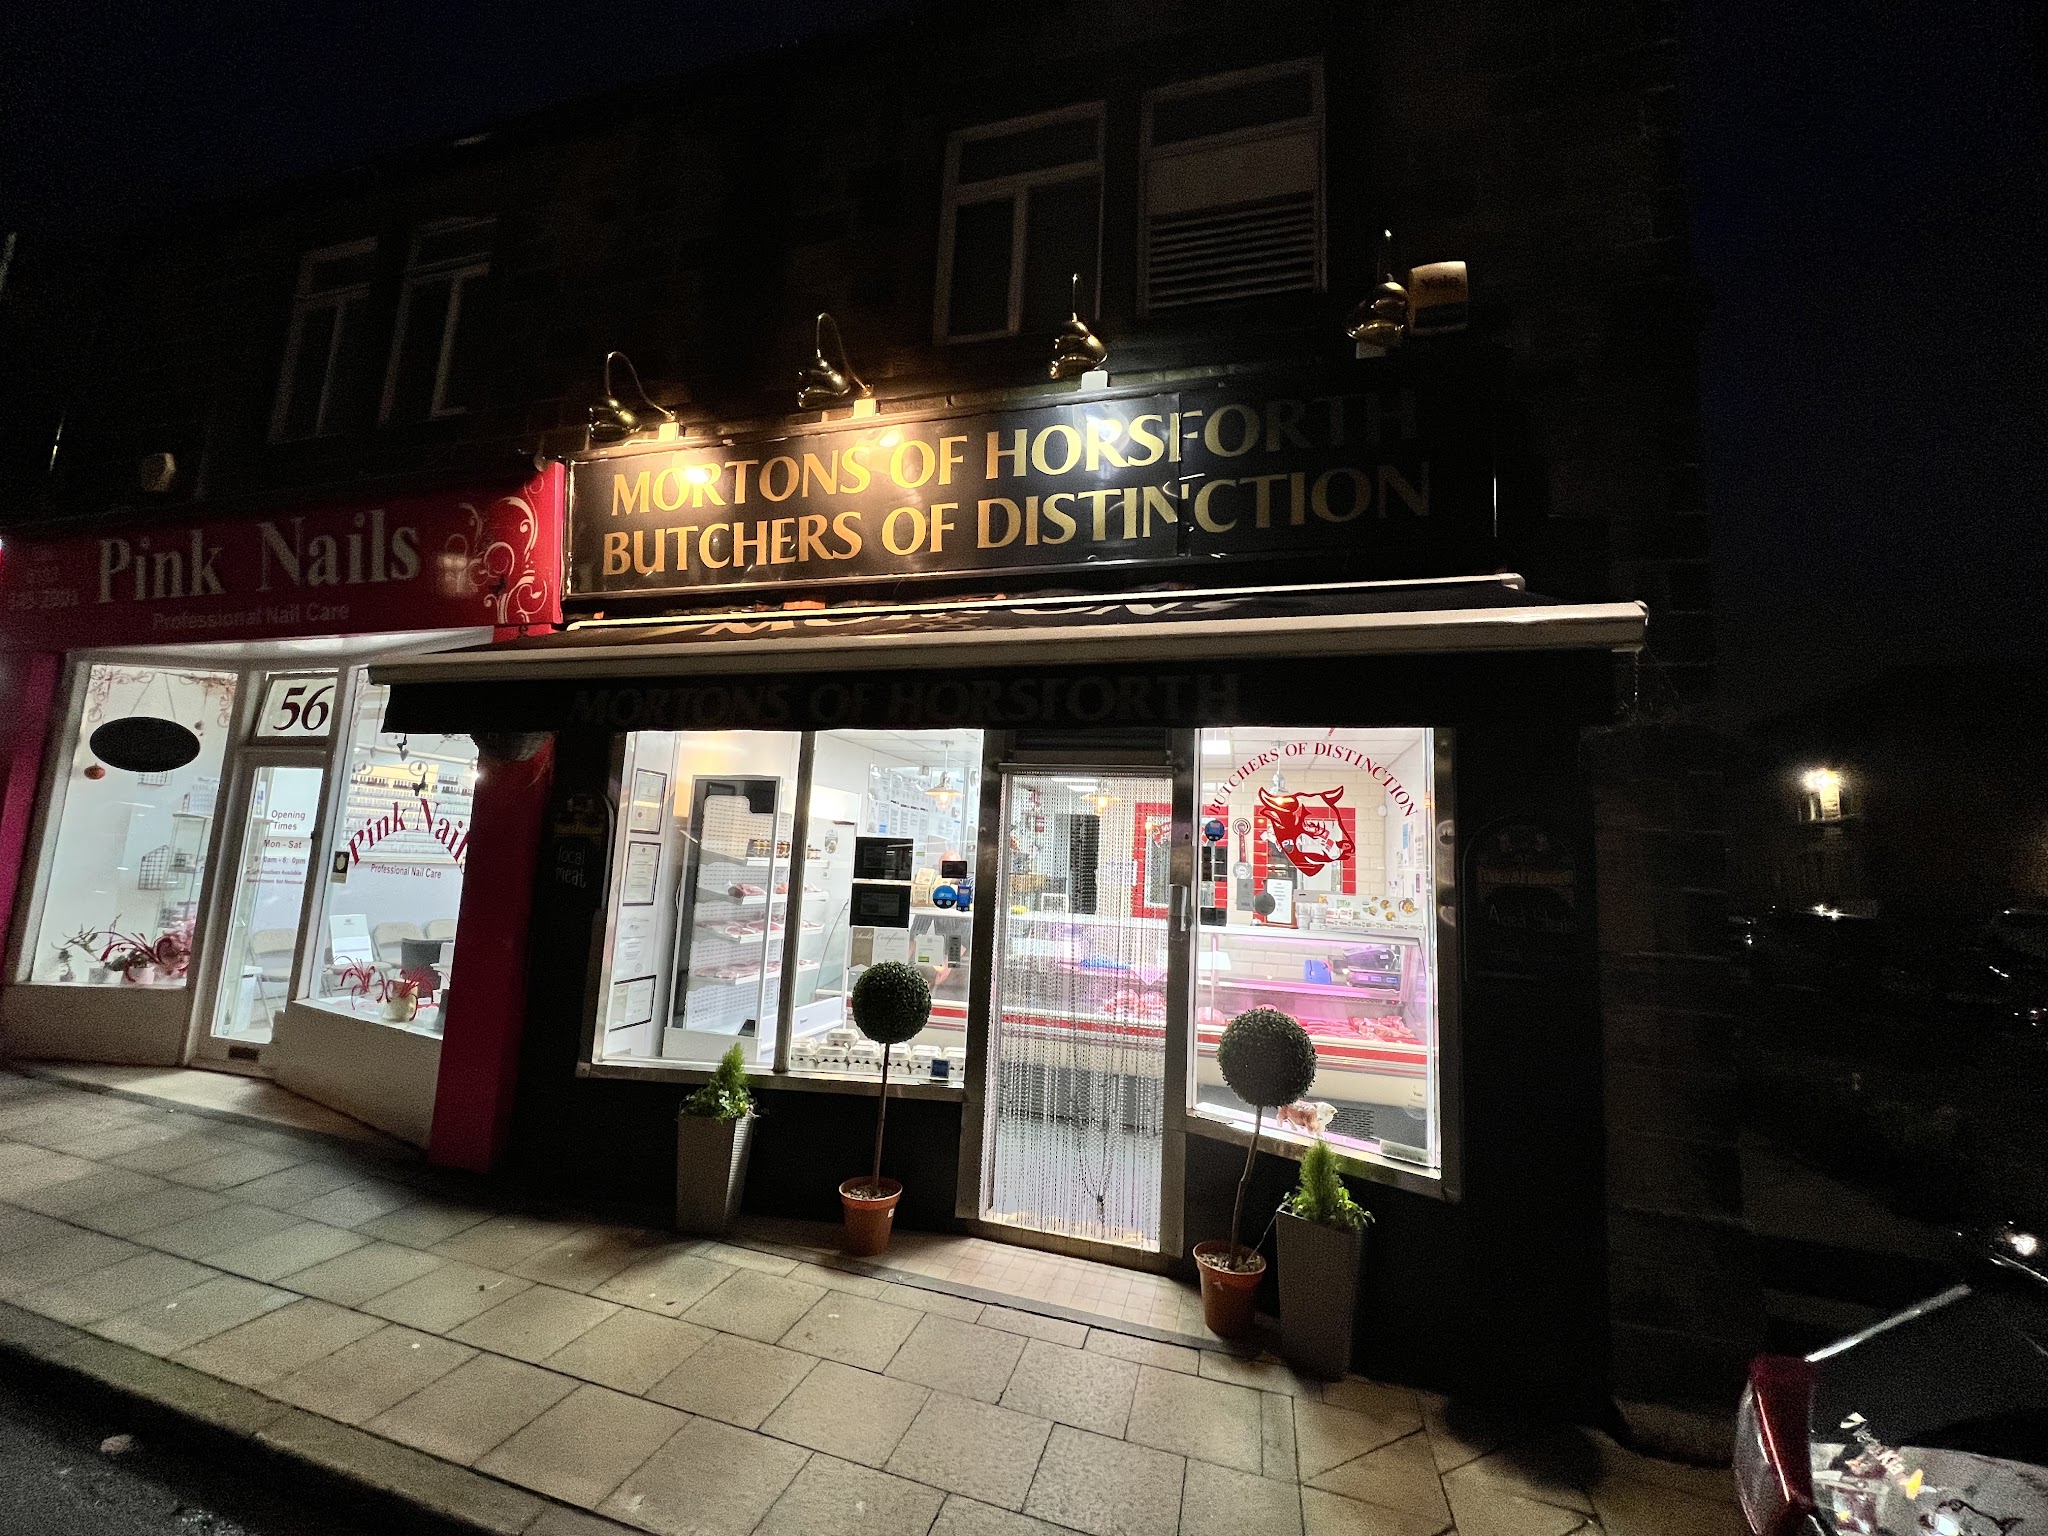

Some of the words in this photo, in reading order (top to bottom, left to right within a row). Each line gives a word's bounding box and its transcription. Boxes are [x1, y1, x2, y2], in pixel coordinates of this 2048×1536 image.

[611, 446, 871, 516] MORTONS
[890, 434, 967, 489] OF
[984, 387, 1417, 480] HORSFORTH
[602, 511, 862, 576] BUTCHERS
[881, 502, 959, 556] OF
[976, 459, 1430, 549] DISTINCTION
[98, 528, 226, 604] Pink
[256, 509, 421, 593] Nails
[153, 610, 262, 631] Professional
[266, 604, 301, 624] Nail
[306, 602, 350, 622] Care
[273, 685, 334, 730] 56
[567, 684, 790, 725] MORTONS
[808, 682, 875, 722] OF
[887, 673, 1240, 723] HORSFORTH
[1209, 747, 1279, 815] BUTCHERS
[1285, 742, 1308, 757] OF
[1314, 742, 1418, 818] DISTINCTION
[271, 810, 306, 821] Opening
[274, 822, 297, 830] Times
[348, 801, 407, 868] Pink
[264, 840, 280, 848] Mon
[288, 840, 302, 849] Sat
[370, 863, 410, 876] Professional
[411, 867, 424, 876] Nail
[426, 868, 442, 879] Care
